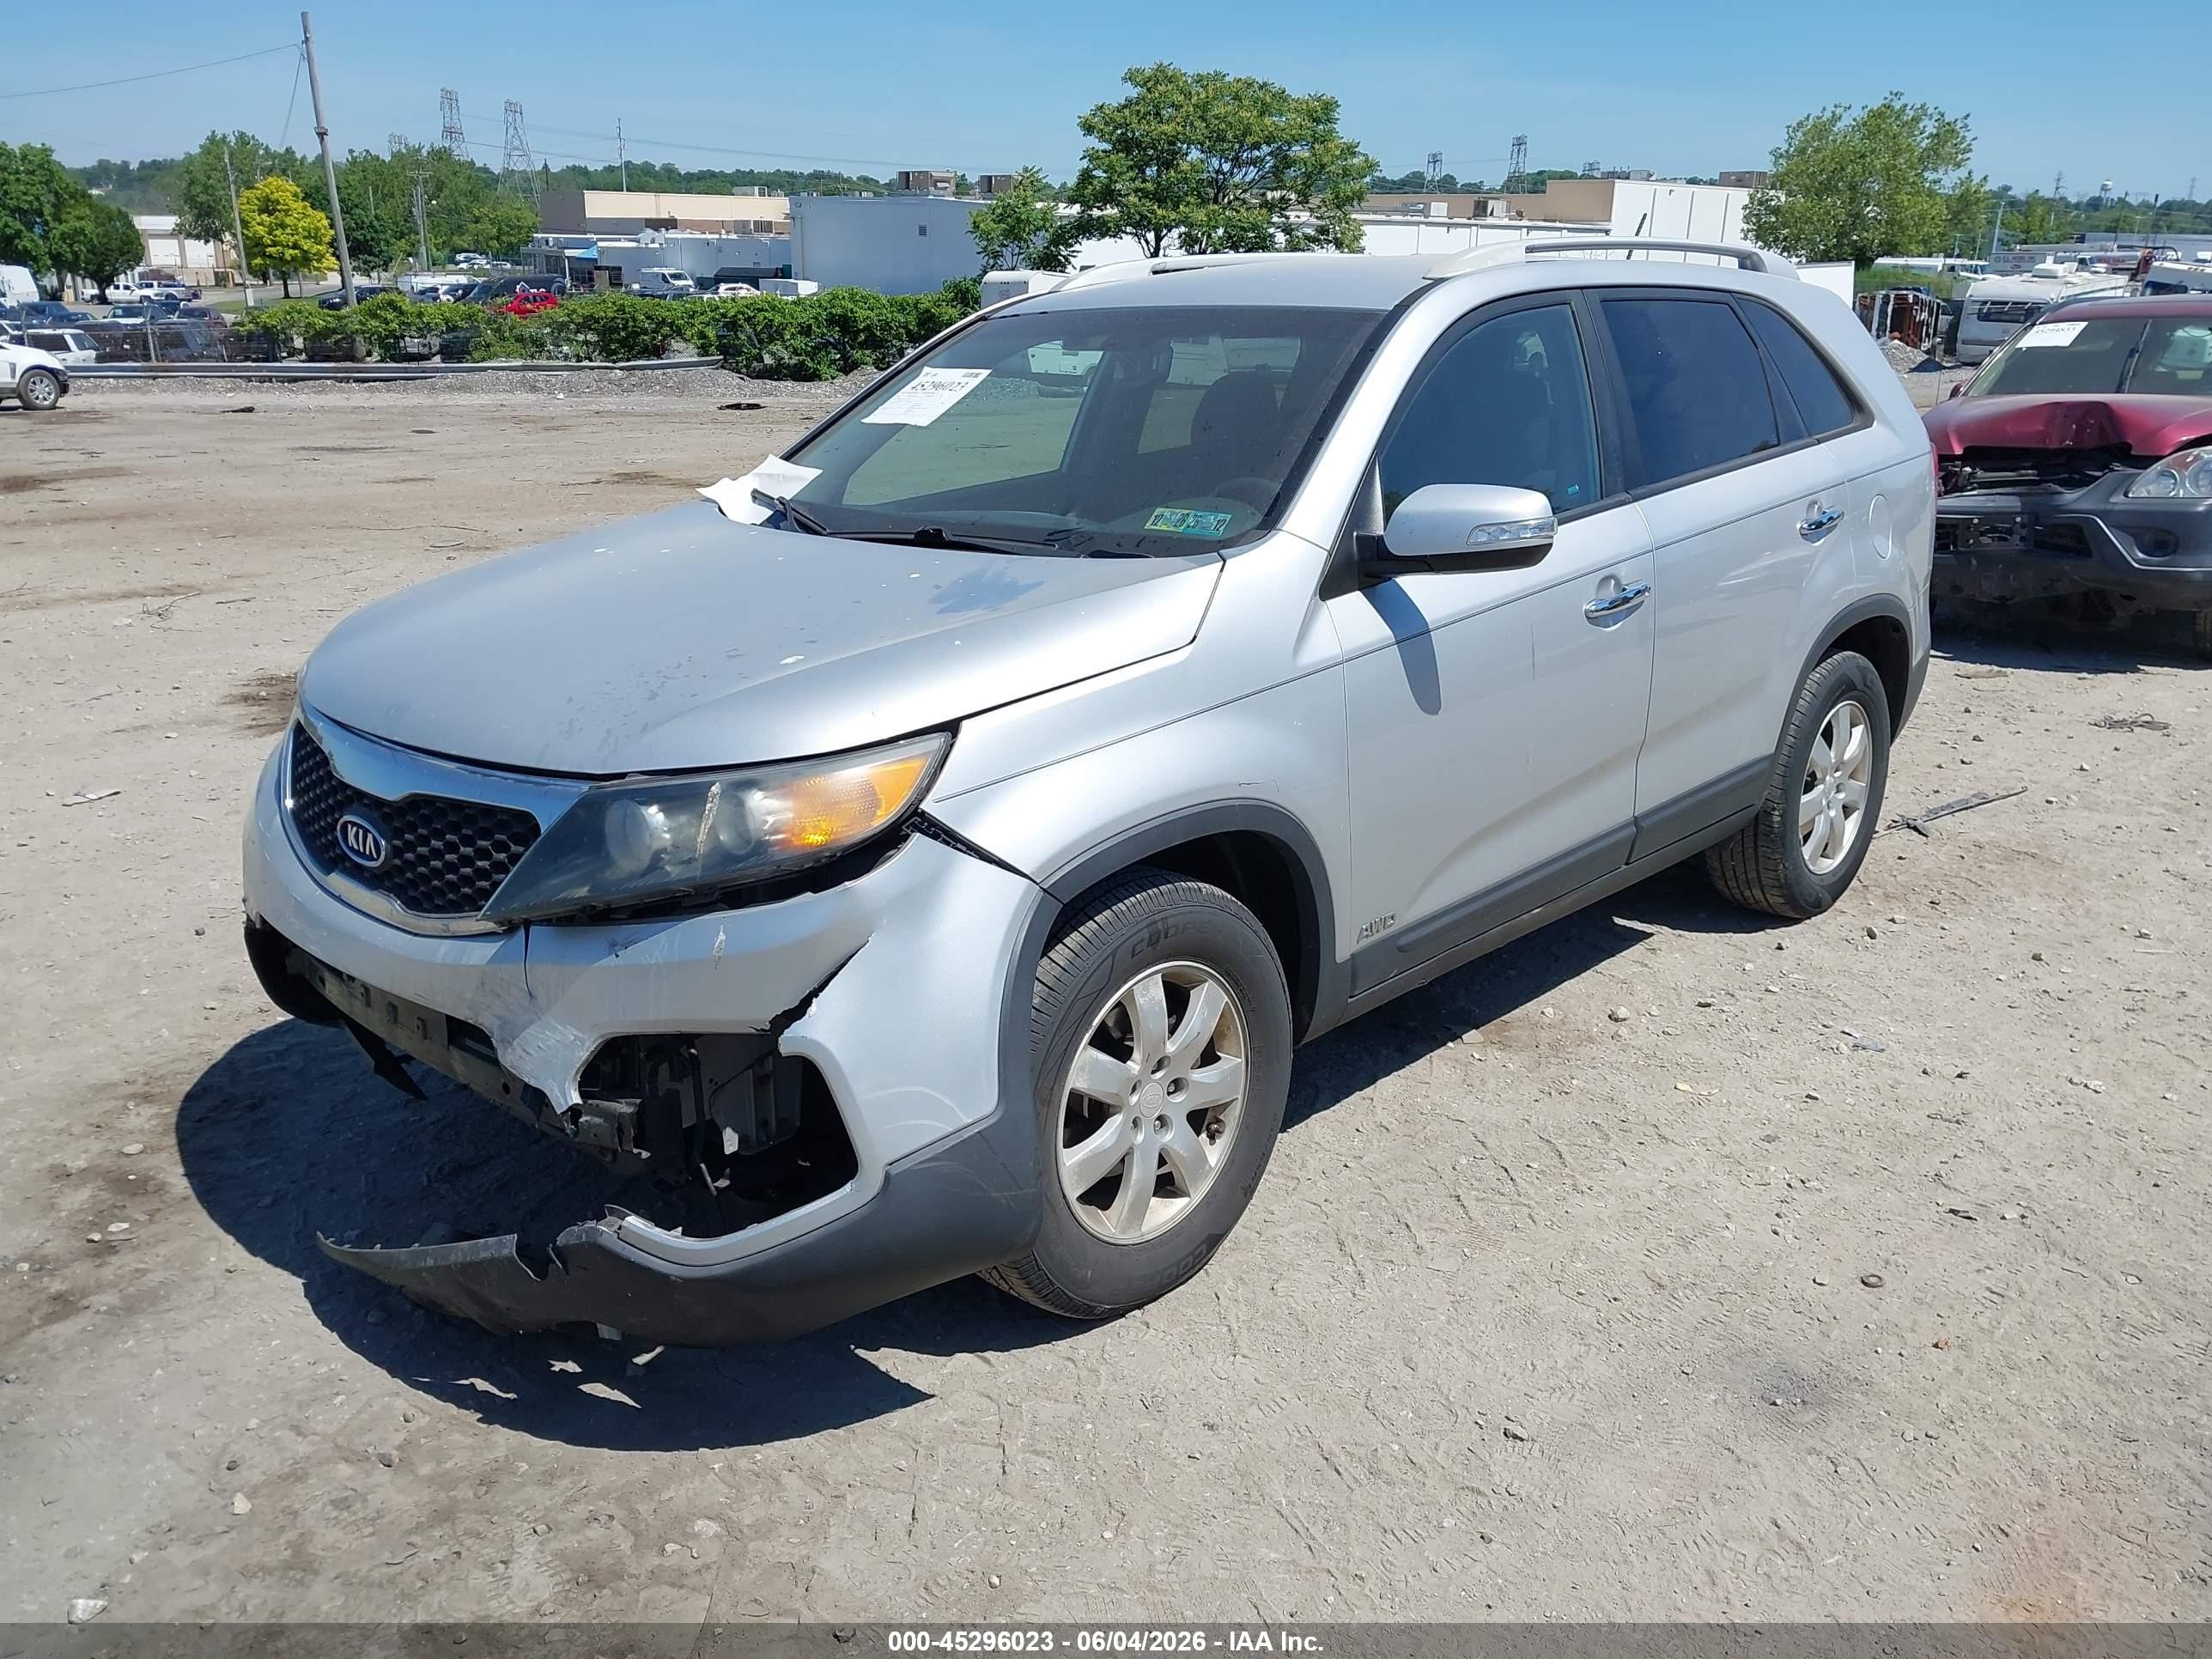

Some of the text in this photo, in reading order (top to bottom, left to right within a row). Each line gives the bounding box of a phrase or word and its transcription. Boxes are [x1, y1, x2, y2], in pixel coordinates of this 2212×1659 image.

[1150, 514, 1164, 526] 12
[1212, 519, 1227, 532] 12
[347, 823, 377, 860] KIA
